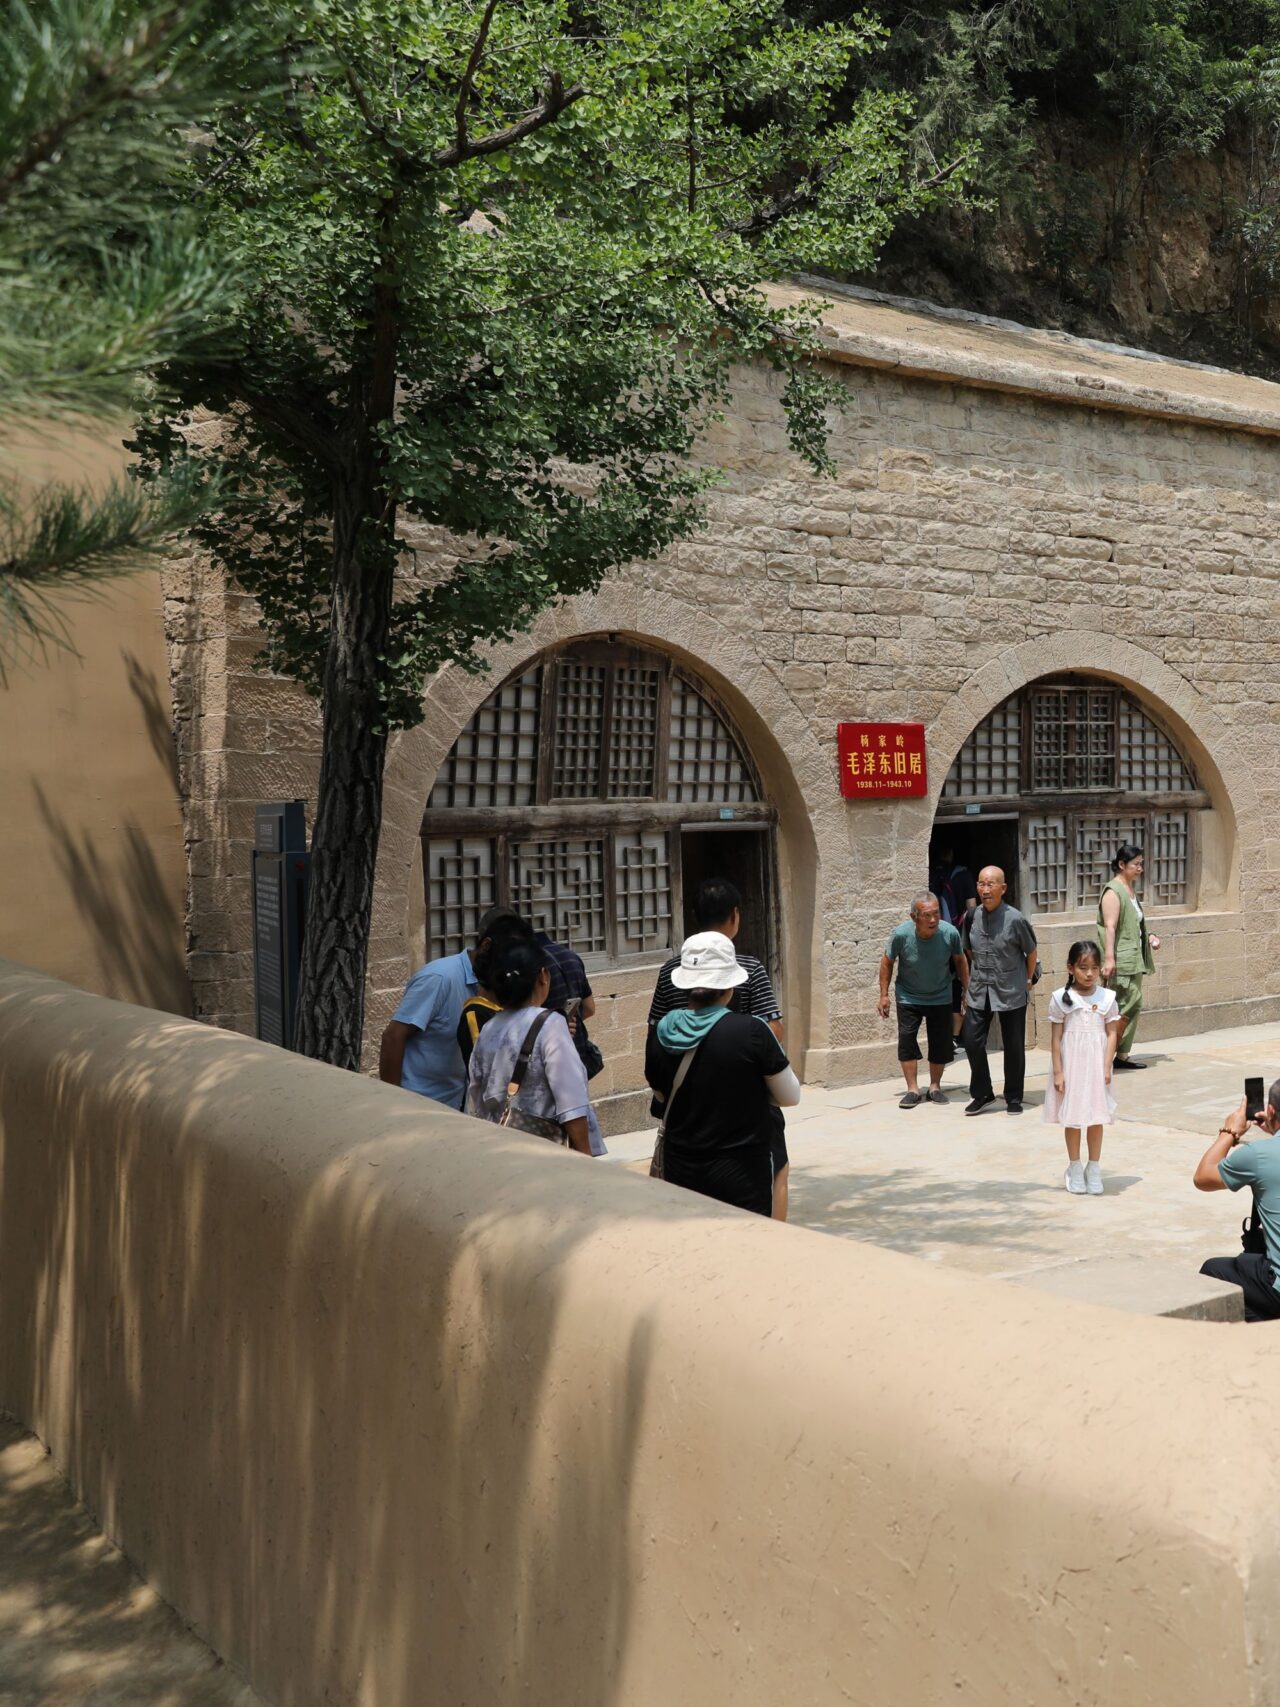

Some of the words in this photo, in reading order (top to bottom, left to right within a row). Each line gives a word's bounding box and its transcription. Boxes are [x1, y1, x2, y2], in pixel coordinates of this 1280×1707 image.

[860, 734, 905, 748] 杨家岭
[846, 751, 922, 776] 毛泽东旧居
